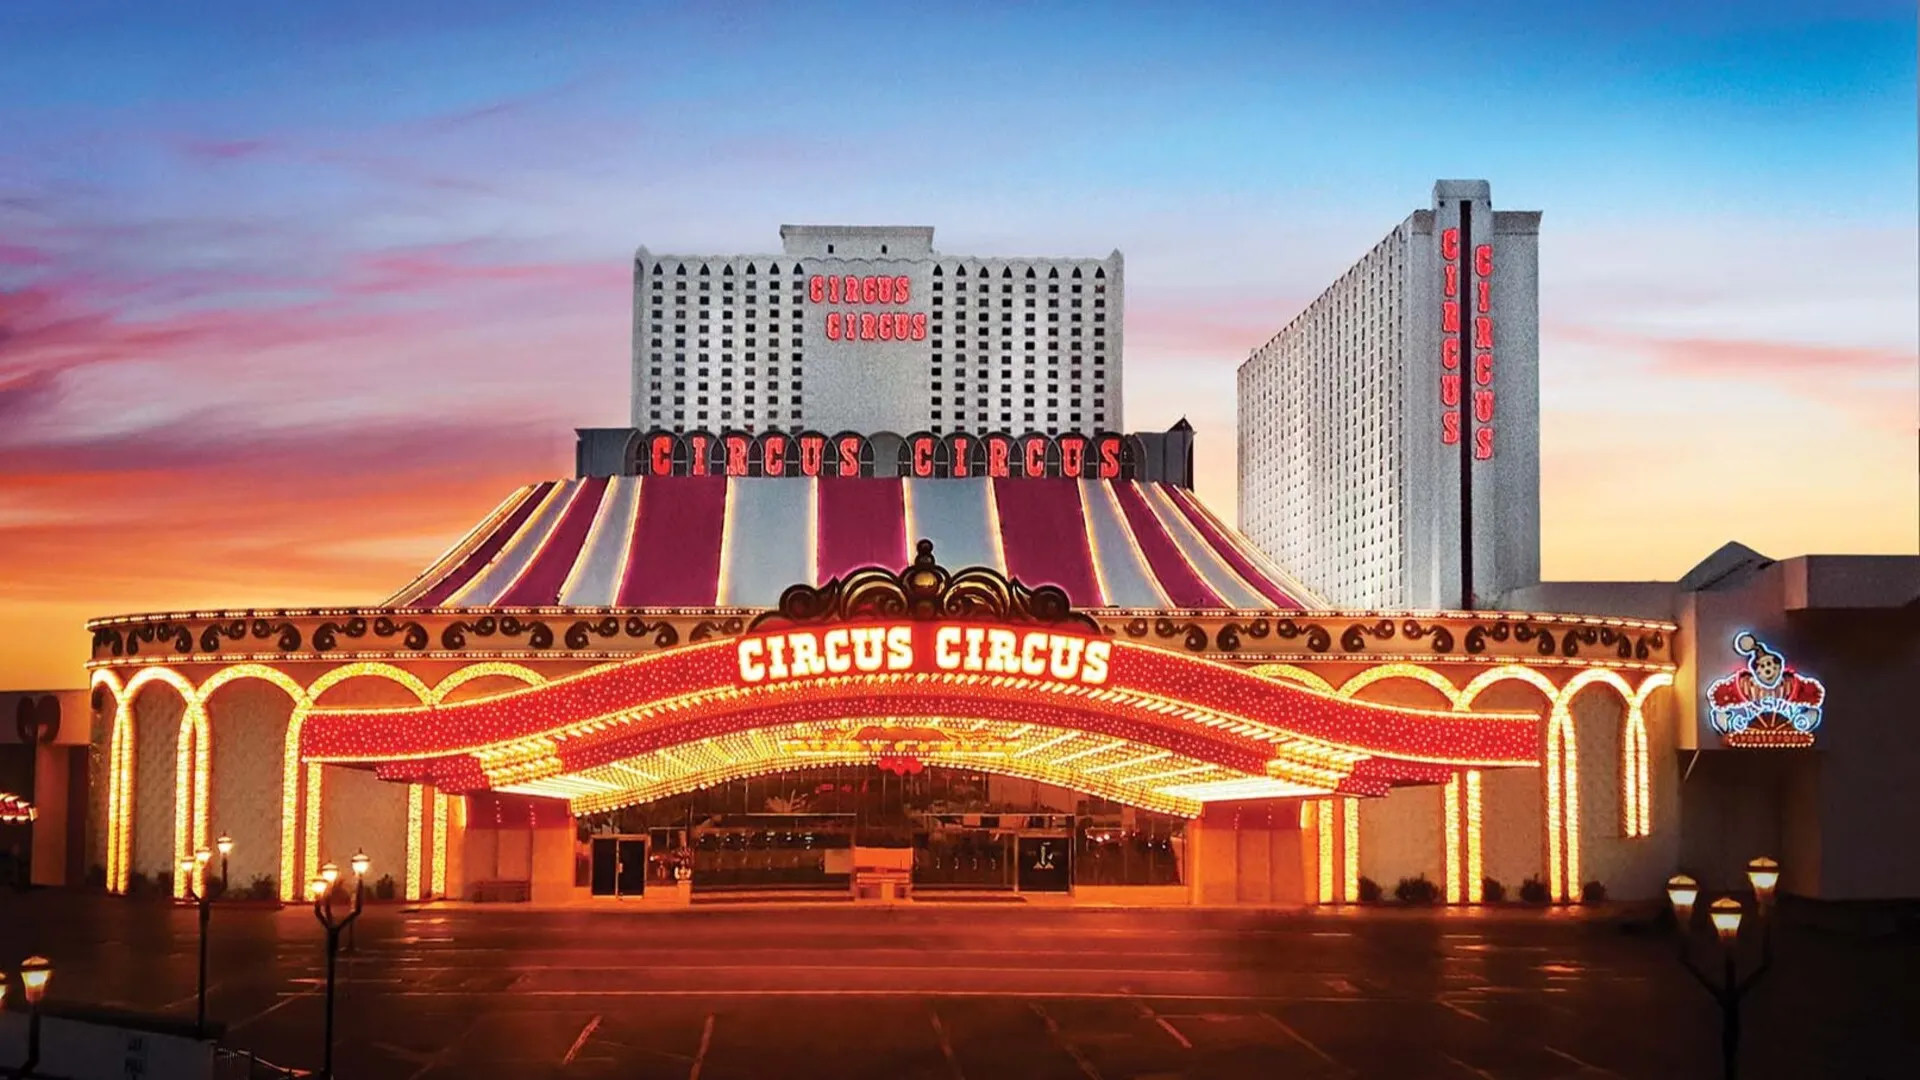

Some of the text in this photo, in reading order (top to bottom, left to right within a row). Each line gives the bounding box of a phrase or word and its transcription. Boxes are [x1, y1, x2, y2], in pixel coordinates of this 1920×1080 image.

[810, 275, 909, 304] CIRCUS
[826, 312, 926, 340] CIRCUS
[1441, 228, 1461, 444] CIRCUS
[1475, 244, 1493, 460] CIRCUS
[652, 436, 1120, 478] CIRCUS CIRCUS
[737, 625, 1112, 684] CIRCUS CIRCUS
[1733, 697, 1810, 732] CASINO
